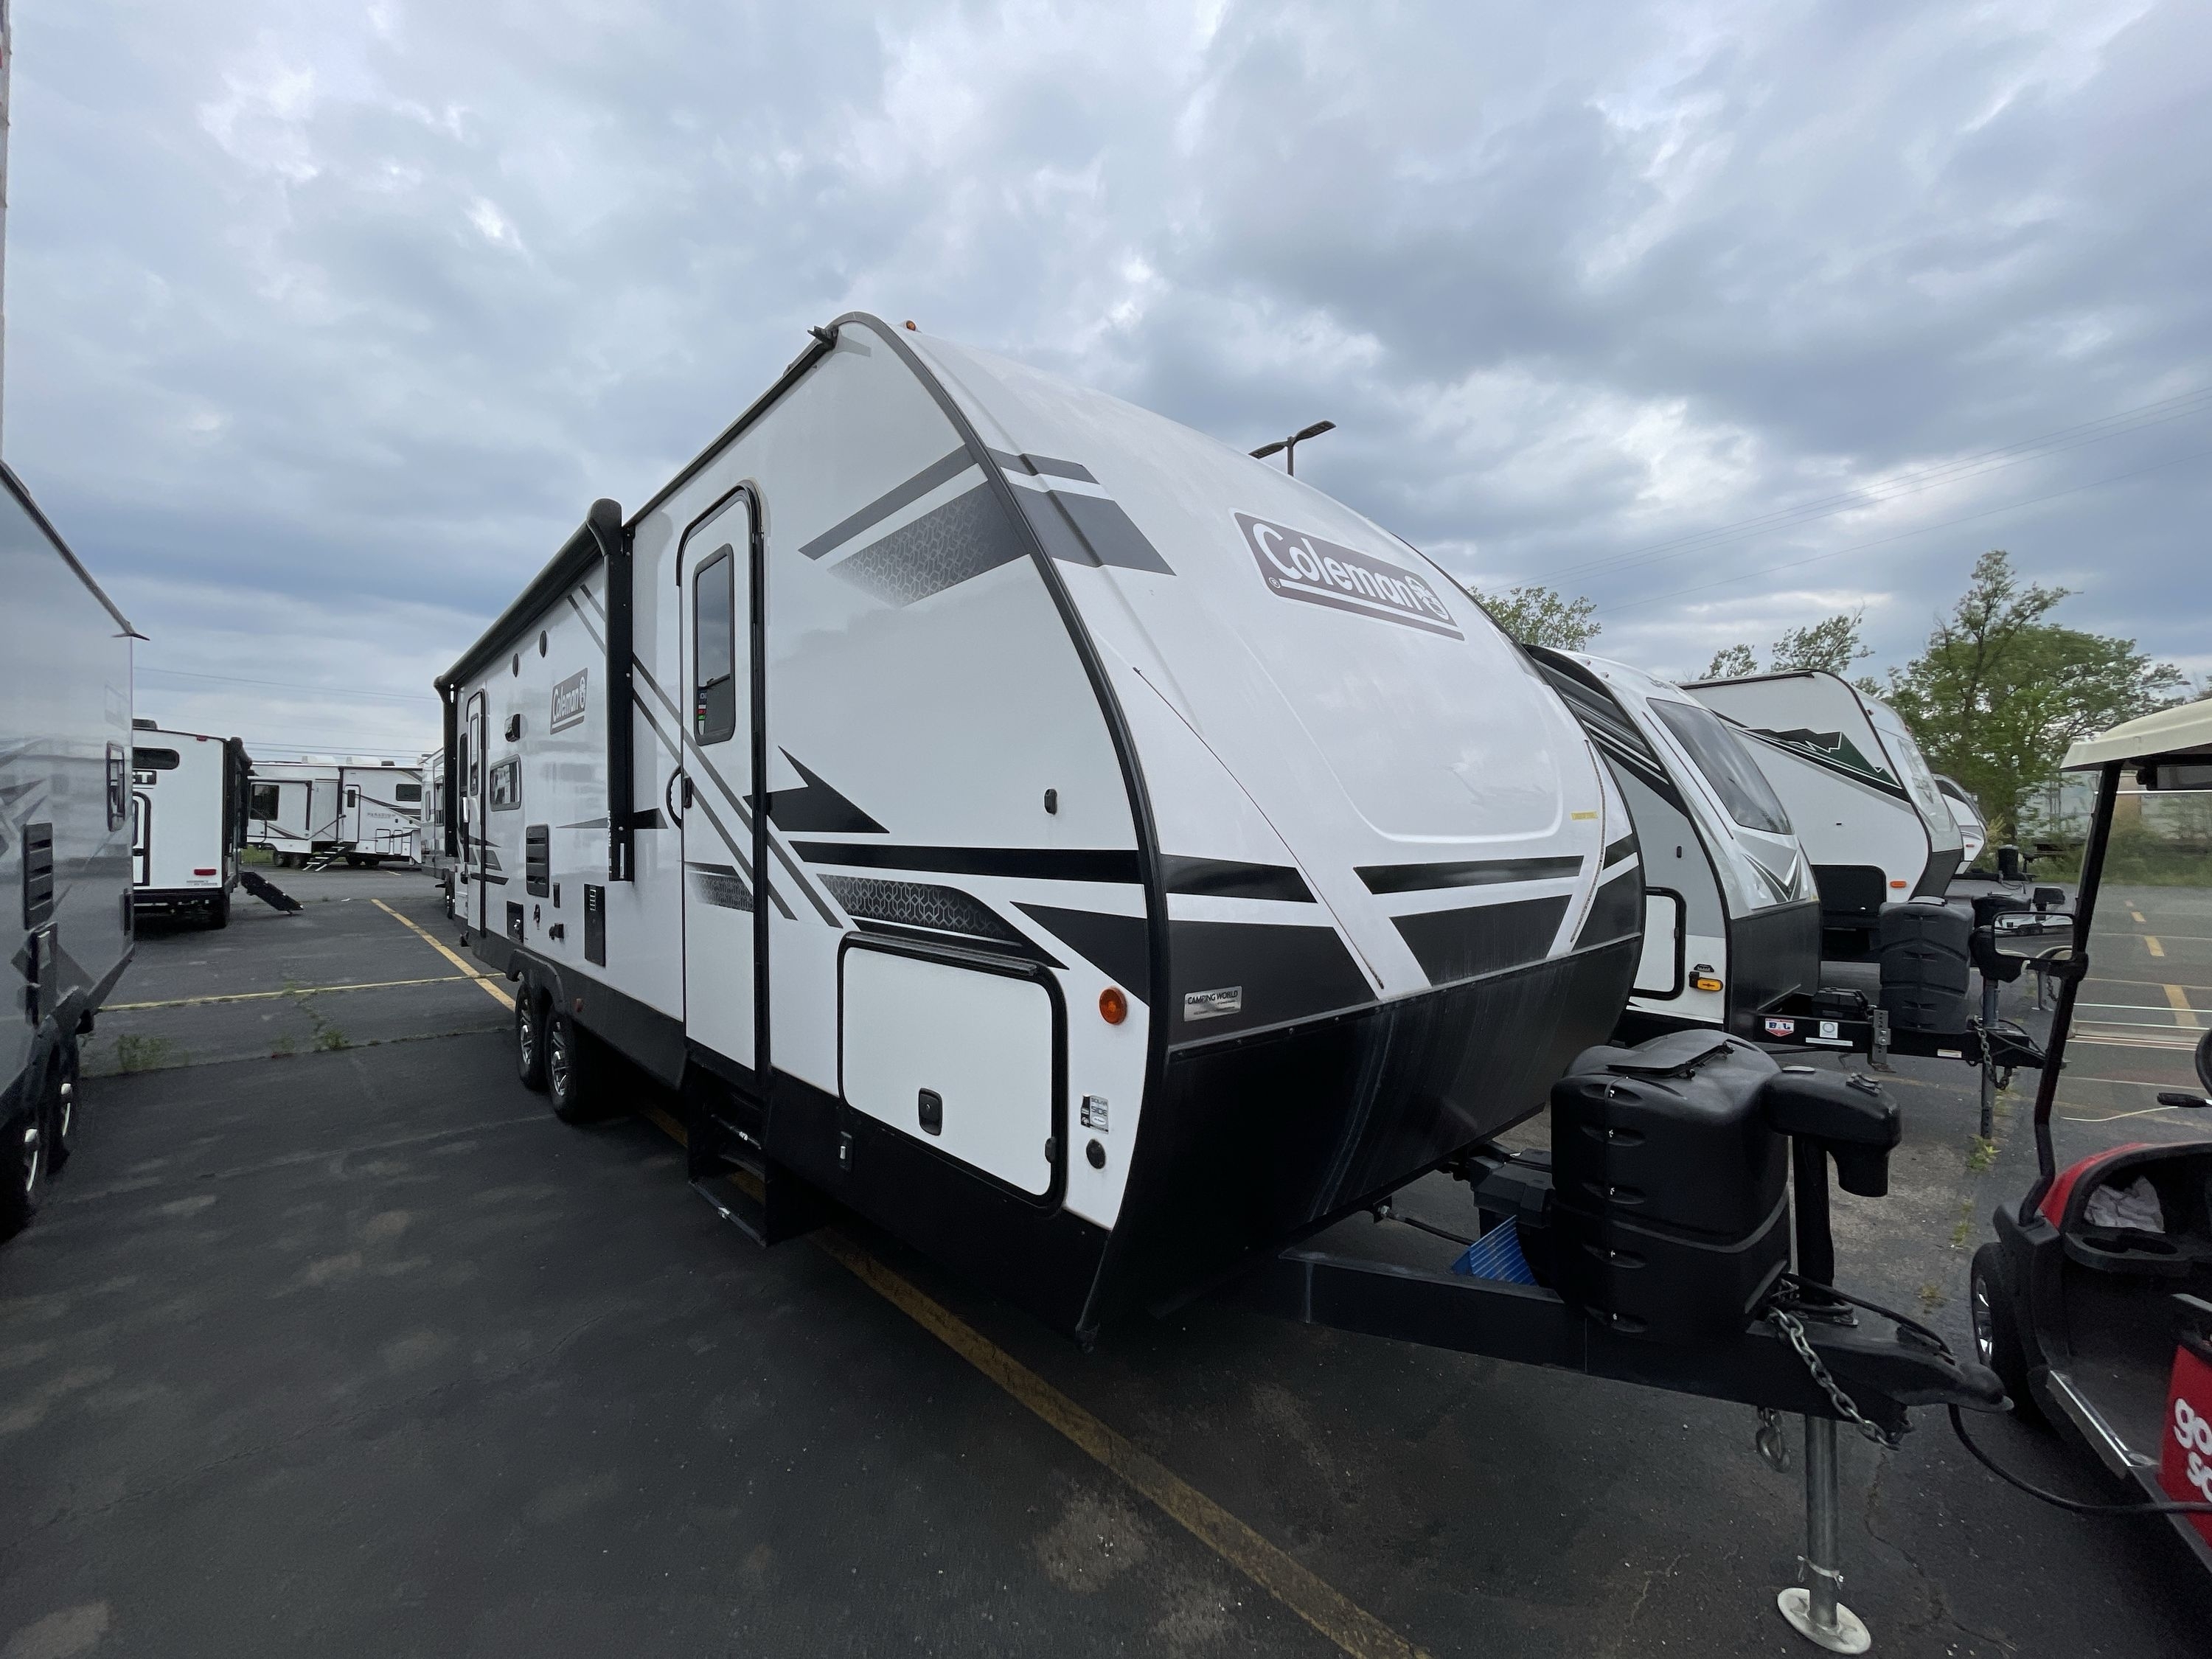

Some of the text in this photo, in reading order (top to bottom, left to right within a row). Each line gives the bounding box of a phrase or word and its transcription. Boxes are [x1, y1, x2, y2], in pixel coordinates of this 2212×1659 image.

[1252, 523, 1425, 612] Coleman
[552, 685, 580, 723] Coleman
[1187, 993, 1216, 1005] CAMPING
[1217, 990, 1239, 1000] WORLD
